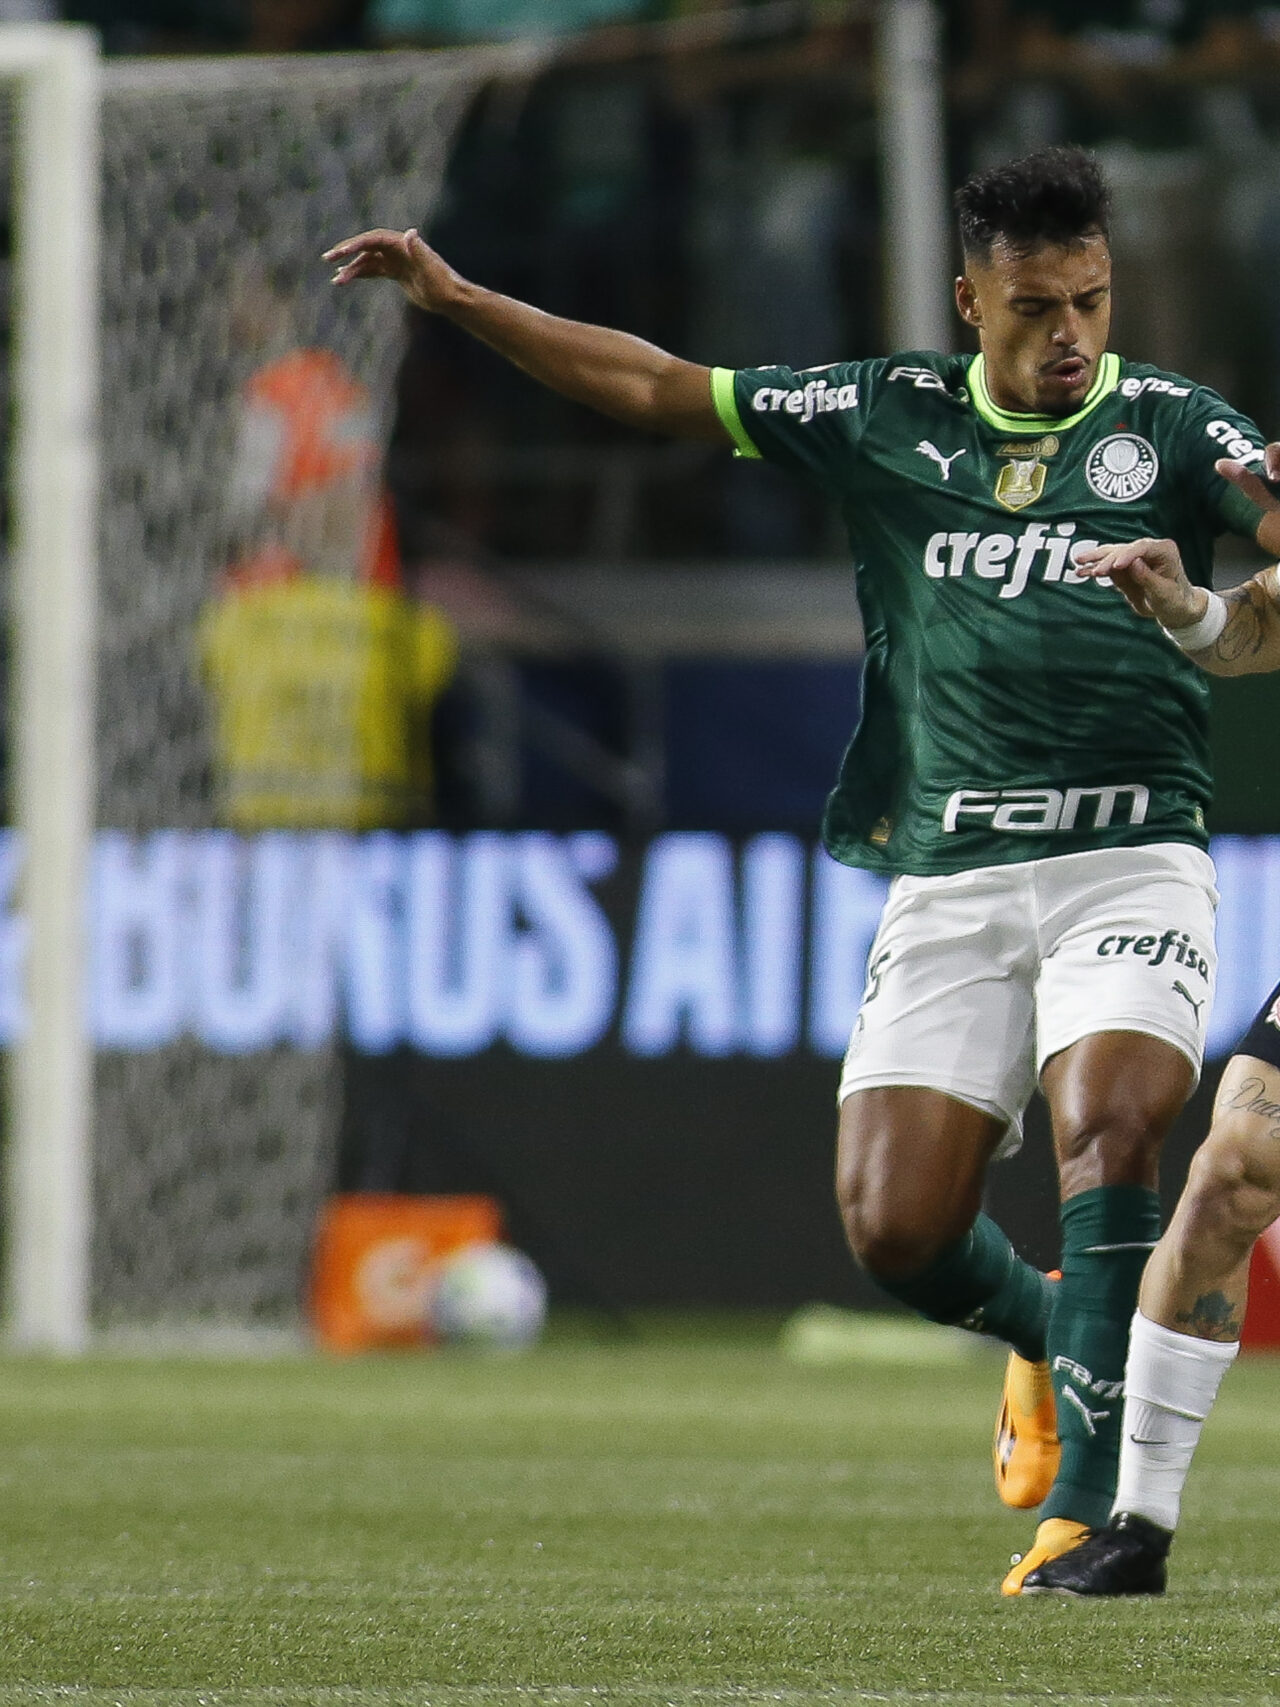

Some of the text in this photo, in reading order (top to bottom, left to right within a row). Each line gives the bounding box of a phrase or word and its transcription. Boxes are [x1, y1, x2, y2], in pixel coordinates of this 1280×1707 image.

[753, 380, 859, 423] crefisa
[1090, 459, 1154, 499] PALMEIRAS
[1097, 929, 1210, 984] crefisa
